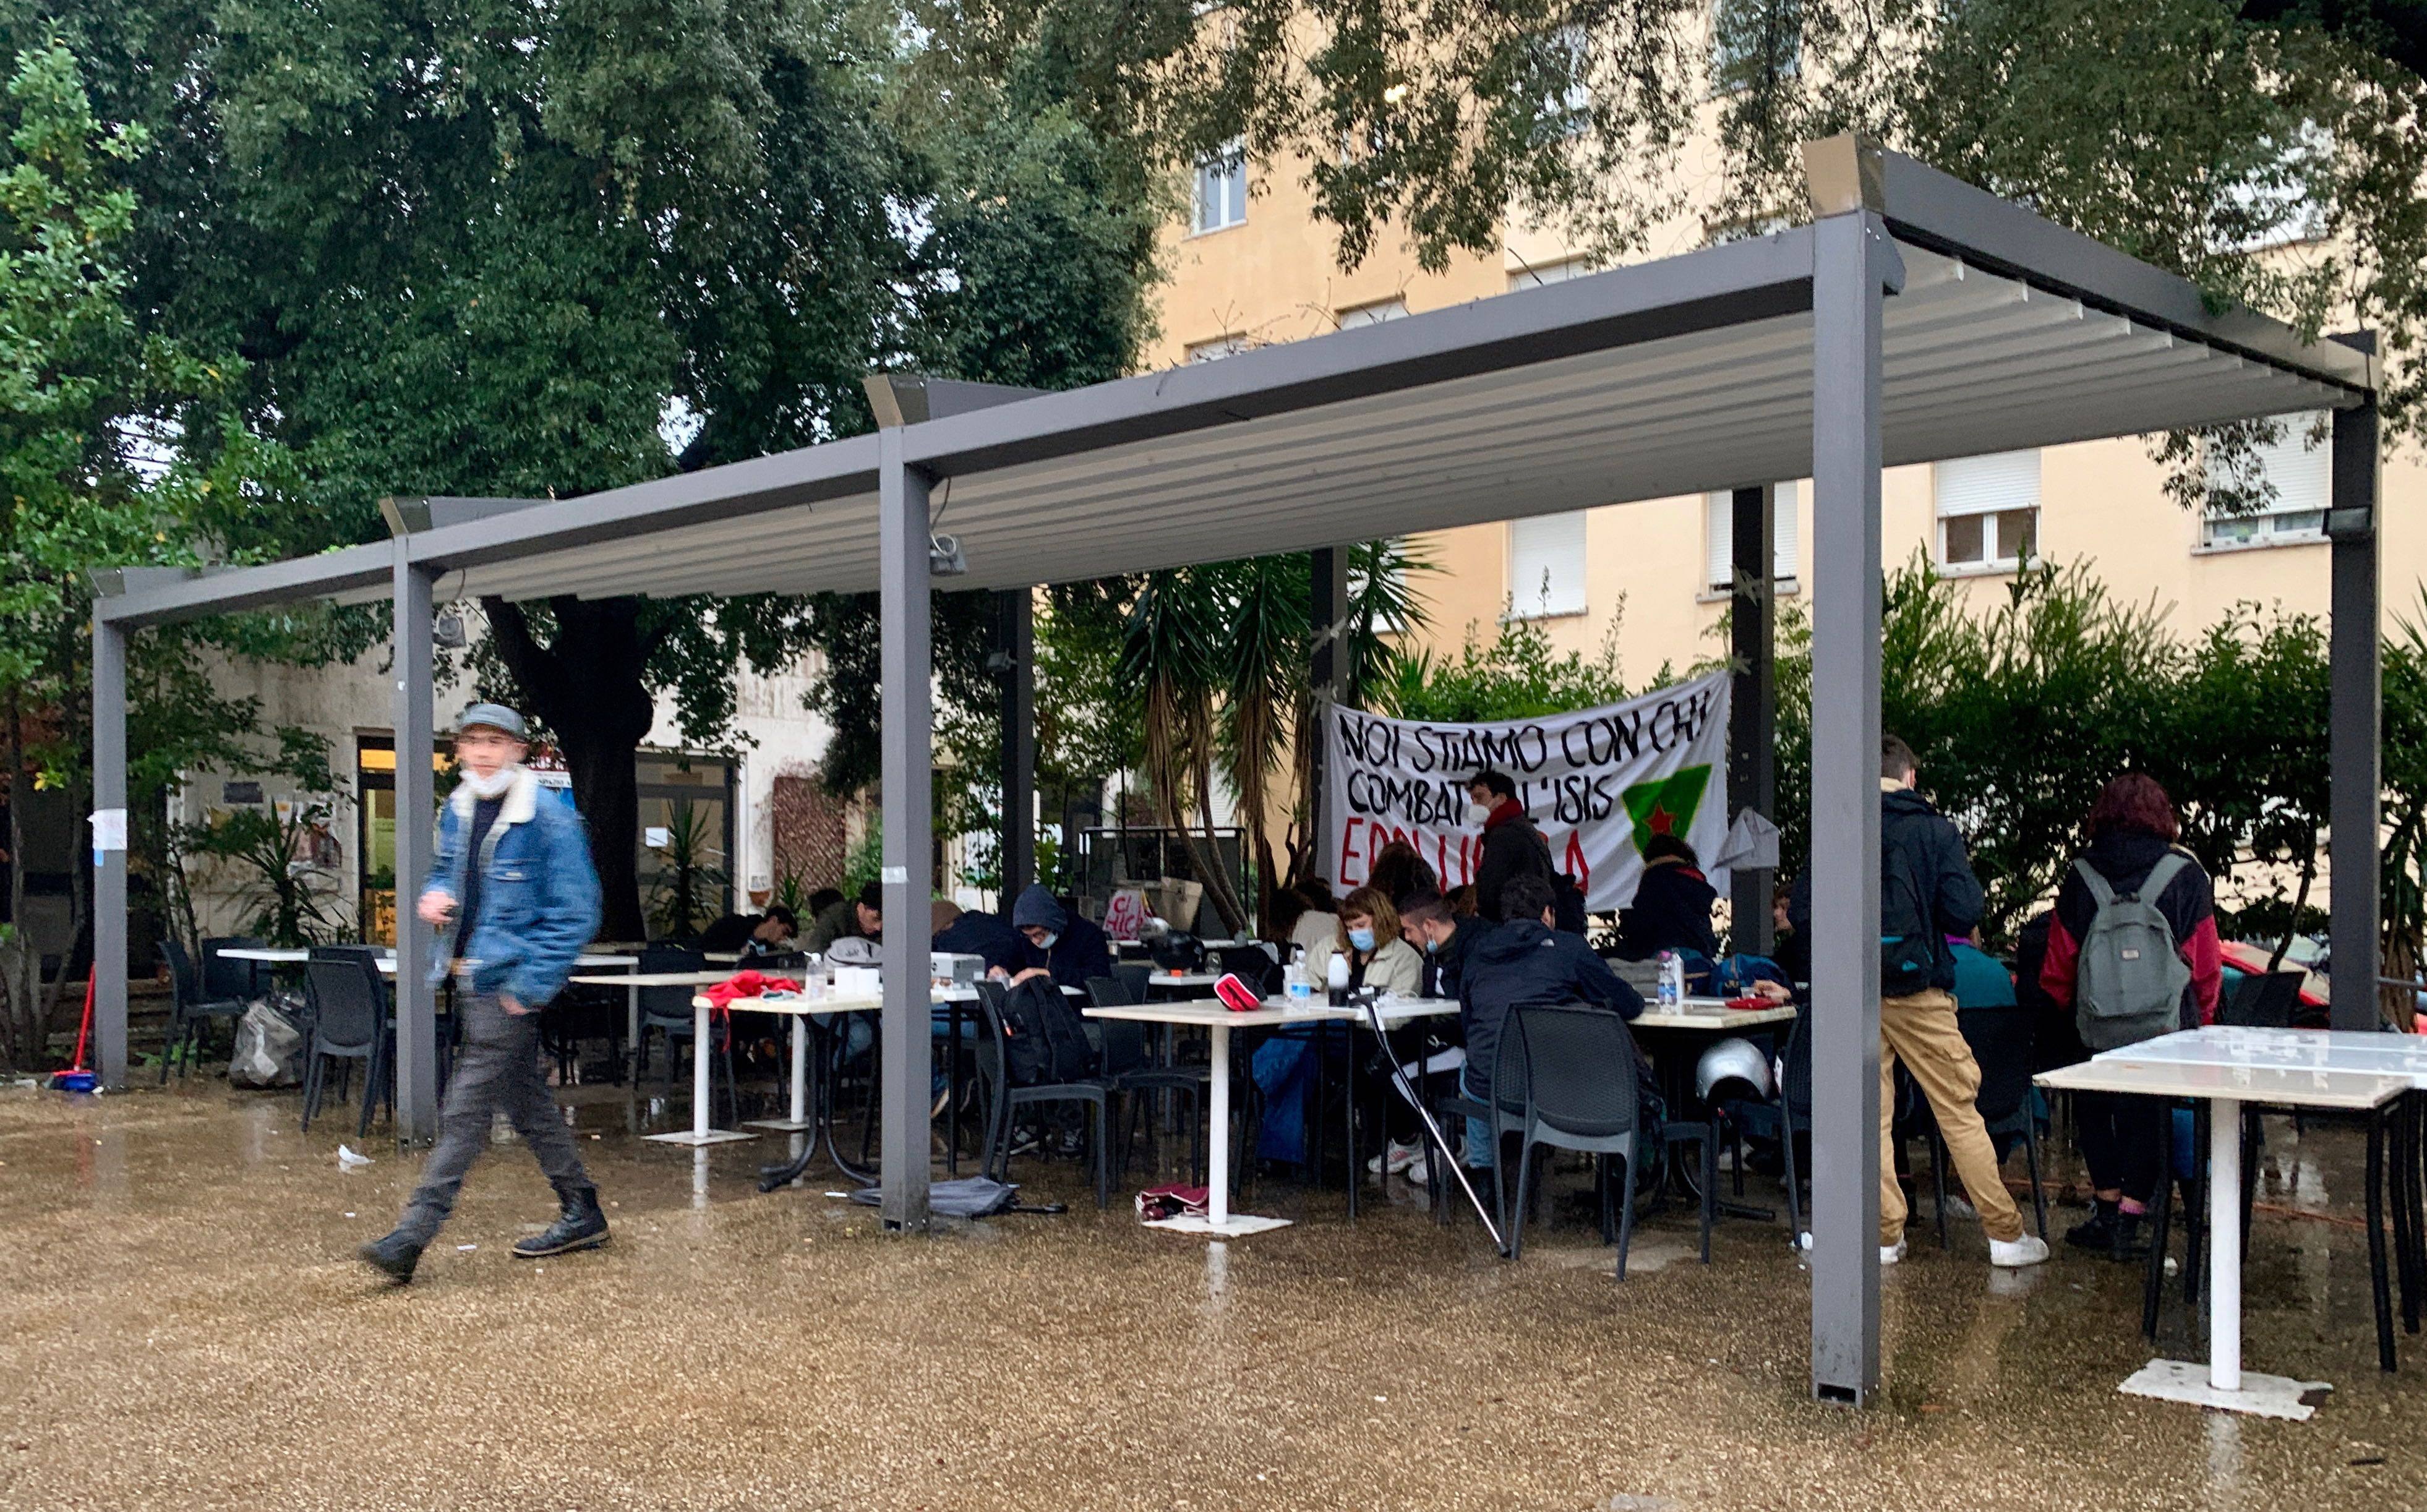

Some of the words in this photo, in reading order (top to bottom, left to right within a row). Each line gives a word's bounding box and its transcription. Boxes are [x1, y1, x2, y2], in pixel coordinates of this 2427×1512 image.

[1338, 713, 1399, 768] NOI
[1412, 724, 1547, 773] STIAMO
[1561, 709, 1641, 768] CON
[1649, 690, 1711, 753] CHI
[1522, 774, 1614, 824] L'ISIS
